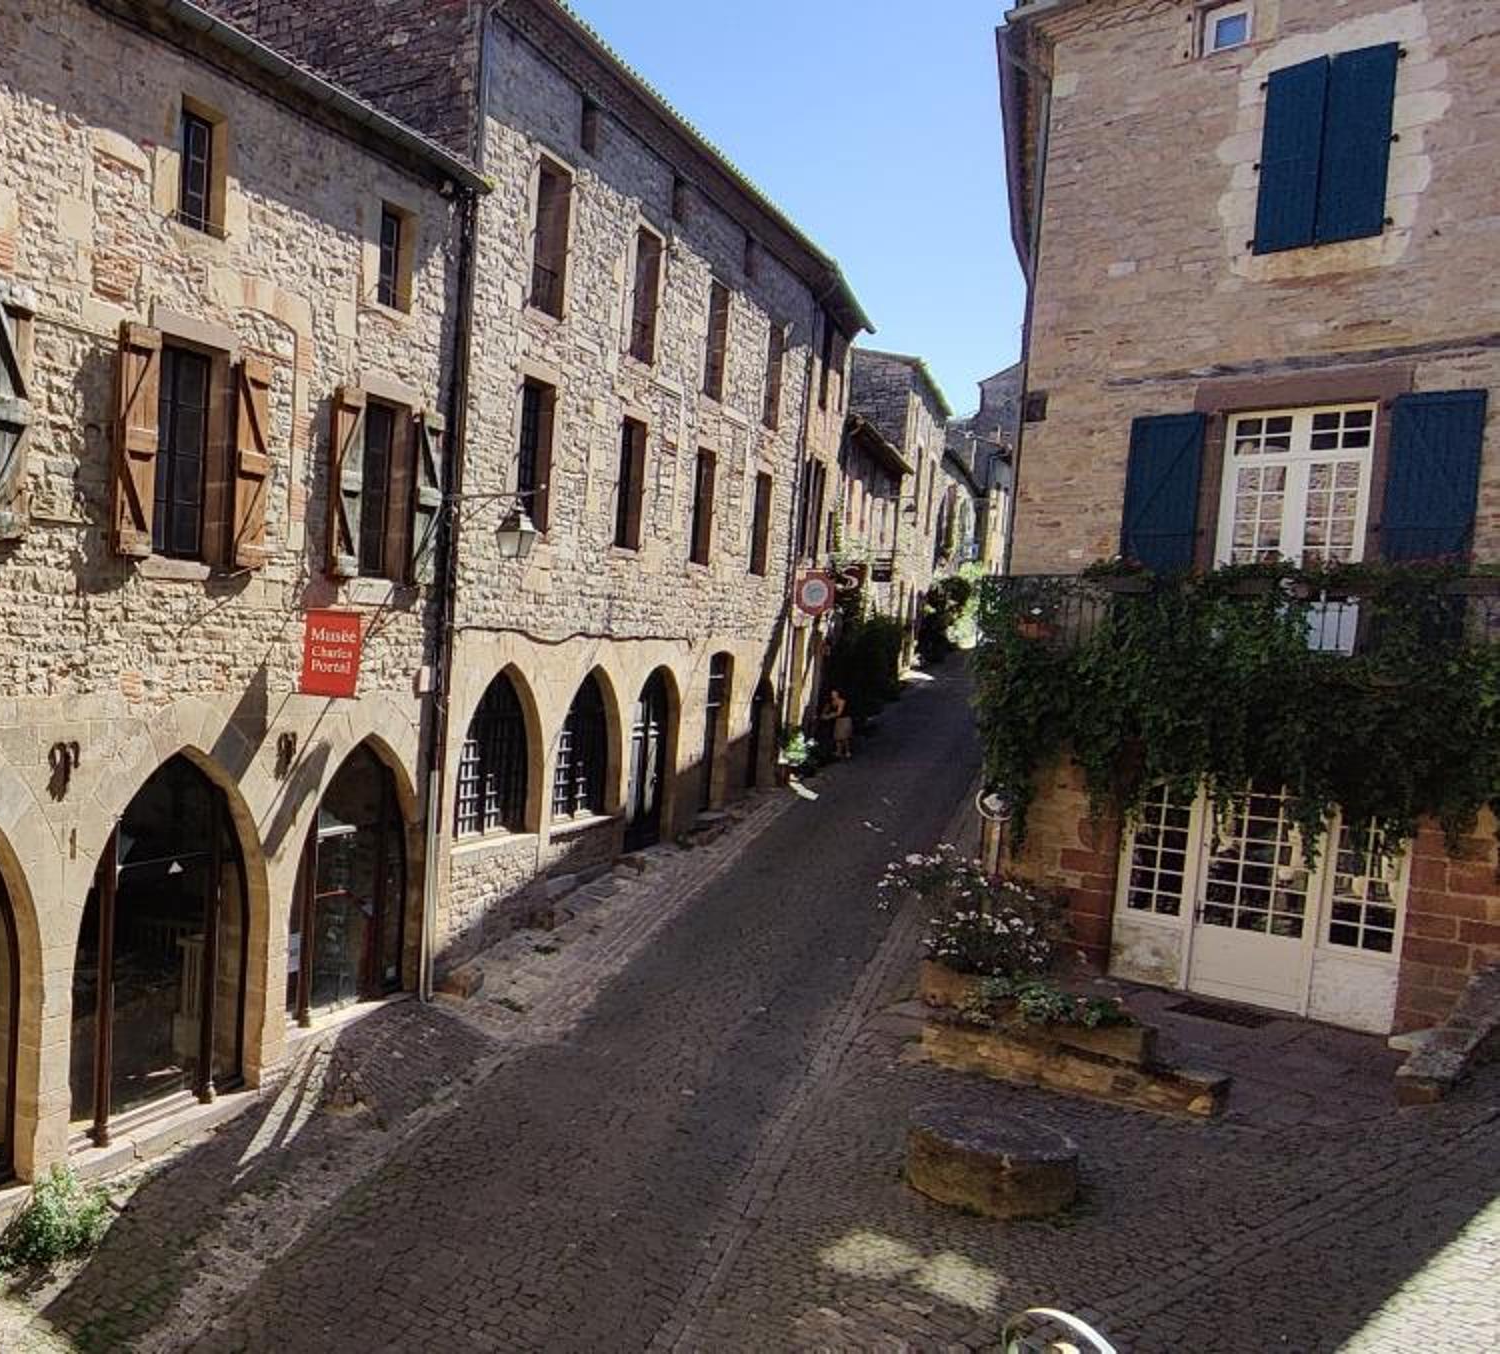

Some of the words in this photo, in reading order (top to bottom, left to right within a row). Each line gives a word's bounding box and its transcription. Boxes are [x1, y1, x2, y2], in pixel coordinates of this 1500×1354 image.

[310, 627, 357, 643] Musée
[311, 645, 353, 659] Charles
[311, 659, 351, 674] Portal
